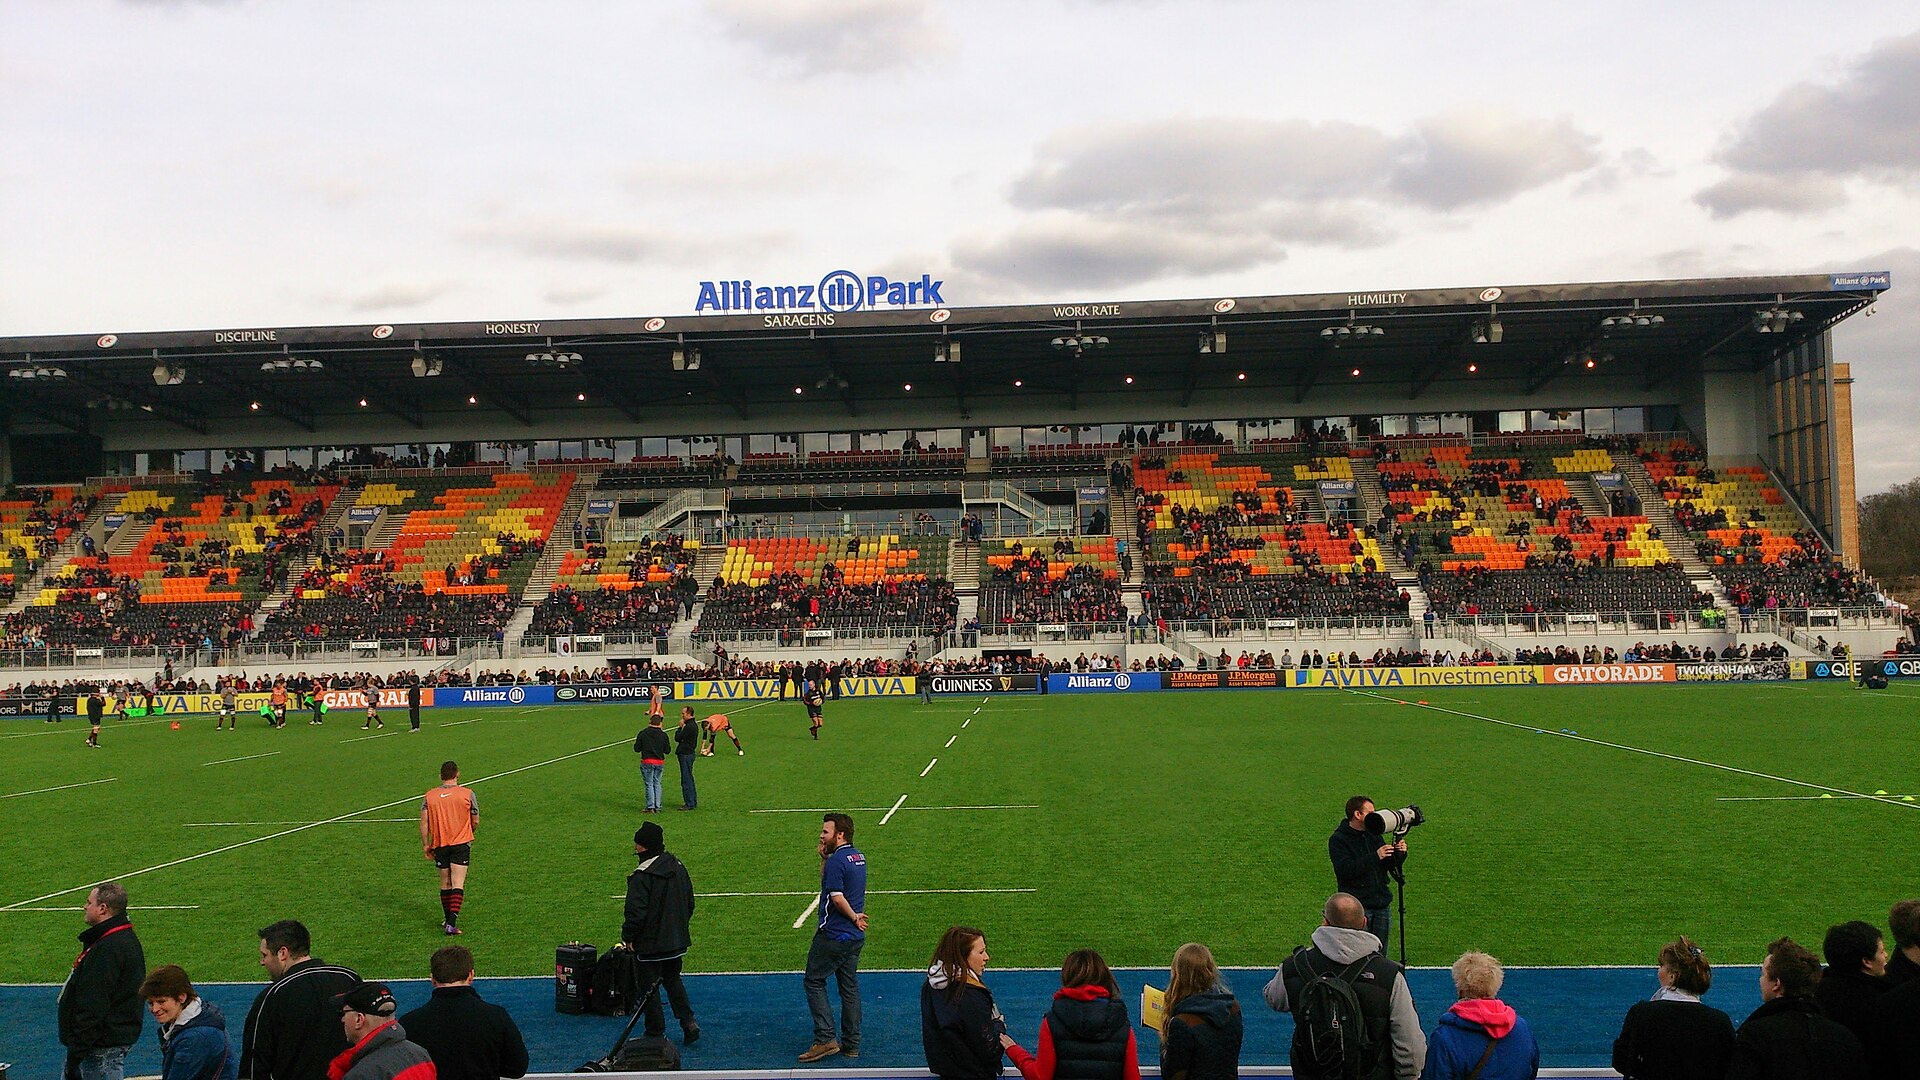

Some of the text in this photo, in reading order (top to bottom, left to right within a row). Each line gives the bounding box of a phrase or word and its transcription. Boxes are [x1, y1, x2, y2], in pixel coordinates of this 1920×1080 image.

[1834, 276, 1887, 285] Allianz Park
[695, 274, 945, 311] Allianz Park
[1347, 293, 1408, 306] HUMILITY
[1053, 304, 1121, 317] WORK RATE
[764, 313, 836, 328] SARACENS
[485, 323, 541, 336] HONESTY
[215, 330, 277, 343] DISCIPLINE
[1554, 664, 1664, 682] GATORADE
[1677, 664, 1756, 675] TWICKENHAM
[1067, 675, 1113, 688] Allianz
[1170, 672, 1219, 682] J.P.Morgan
[1227, 671, 1277, 682] J.P.Morgan
[1320, 667, 1535, 686] AVIVA Investments
[931, 677, 993, 692] GUINNESS
[462, 689, 507, 702] Allianz
[579, 687, 609, 698] LAND
[612, 686, 649, 697] ROVER
[111, 696, 189, 713] VVA
